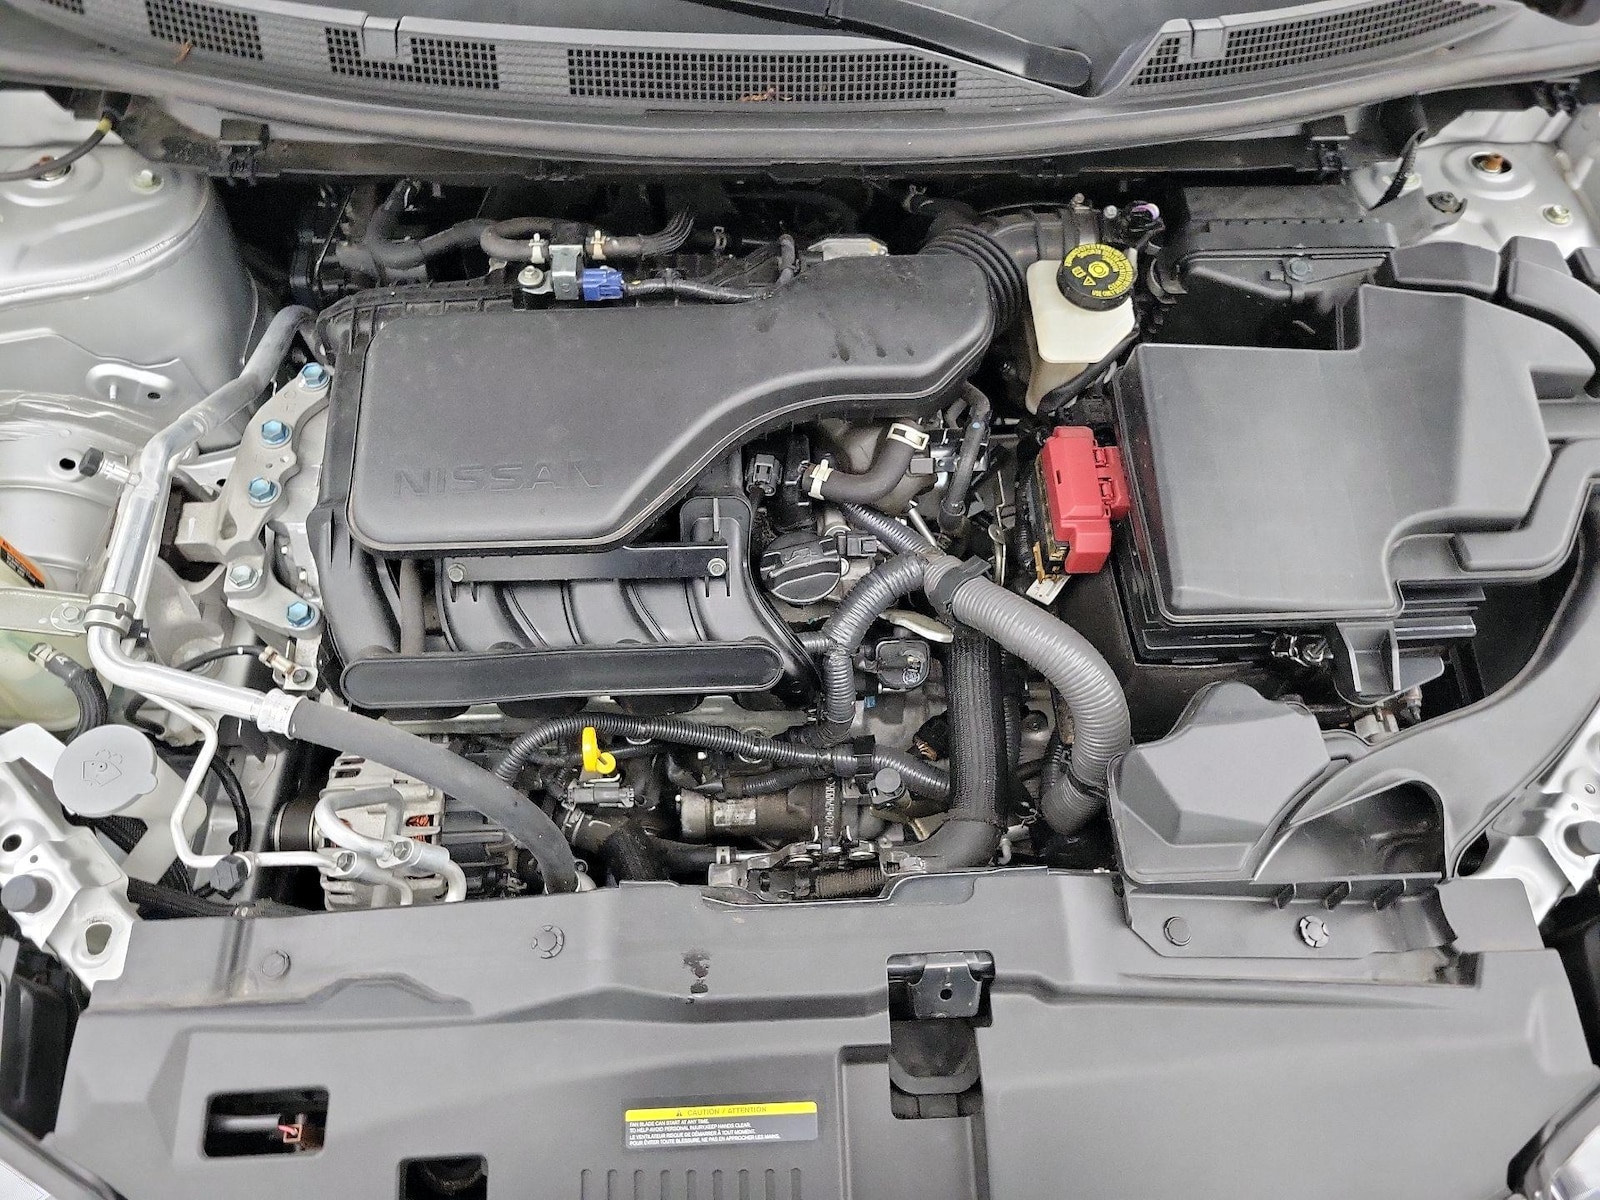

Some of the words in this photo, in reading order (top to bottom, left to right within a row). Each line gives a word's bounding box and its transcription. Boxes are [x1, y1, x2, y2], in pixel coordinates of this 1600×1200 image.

[393, 462, 604, 496] NISSAN
[687, 1108, 720, 1116] CAUTION
[728, 1106, 767, 1114] ATTENTION
